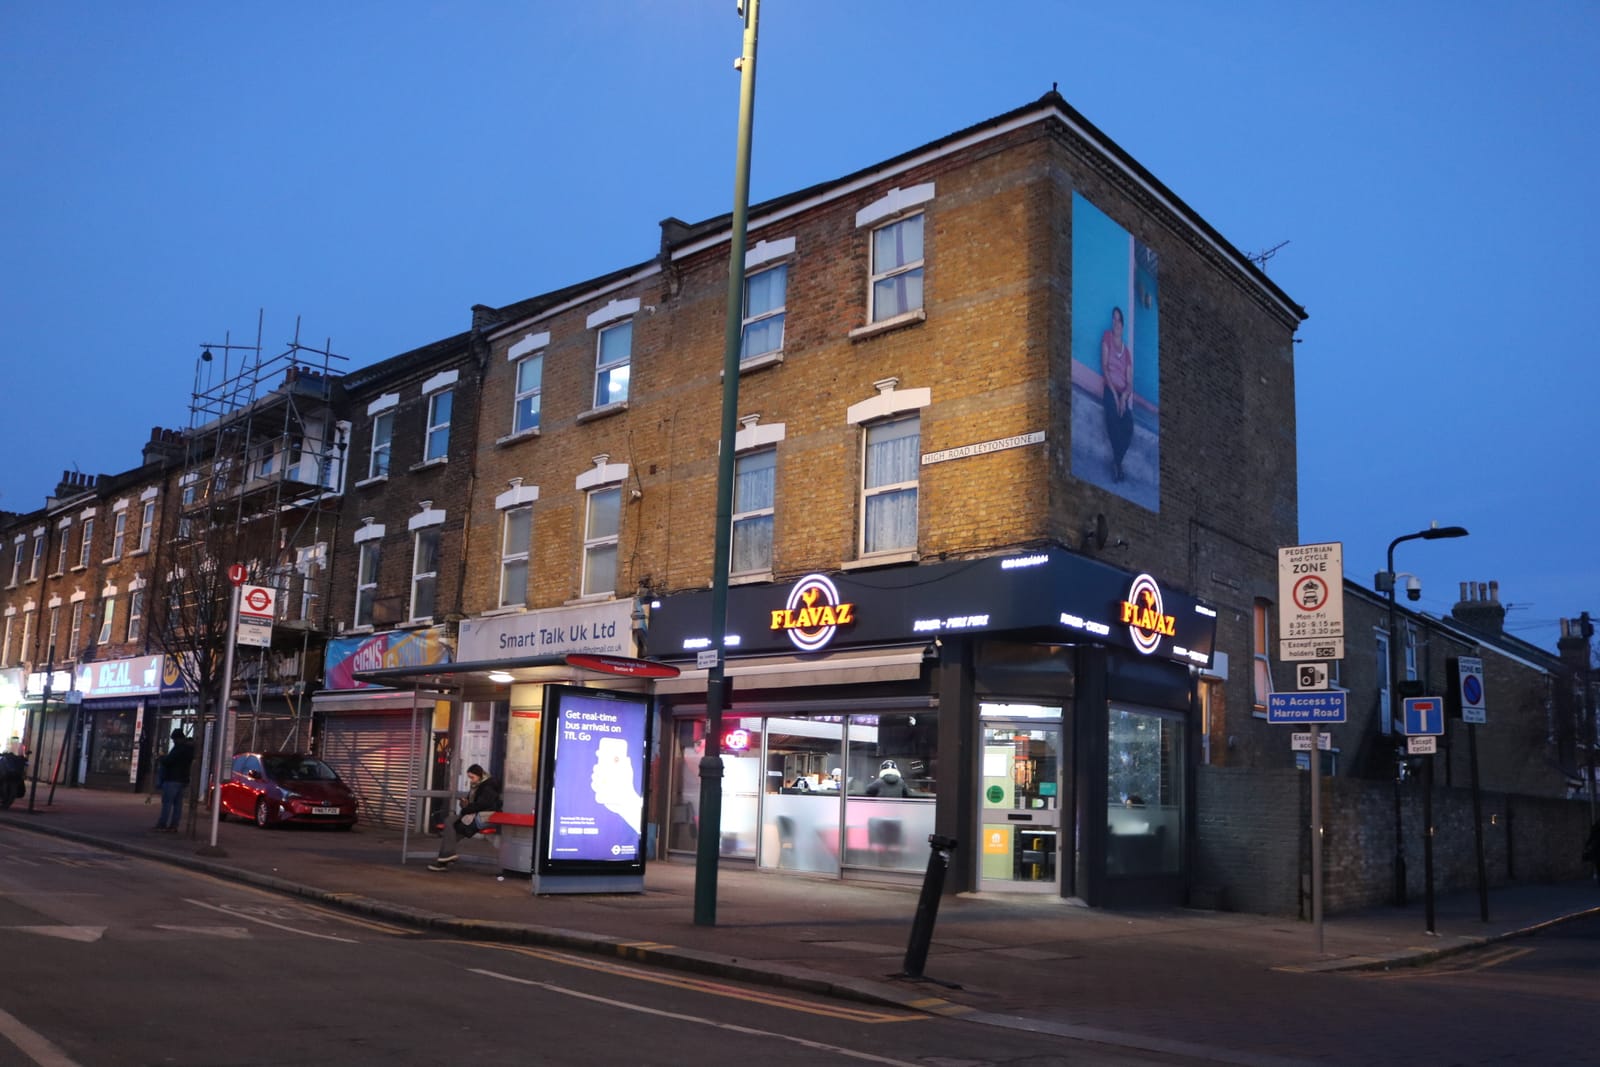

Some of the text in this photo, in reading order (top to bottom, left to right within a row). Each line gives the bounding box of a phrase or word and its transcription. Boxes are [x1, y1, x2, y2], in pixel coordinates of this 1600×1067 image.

[925, 452, 945, 463] HIGH
[948, 447, 970, 460] ROAD
[973, 435, 1033, 454] LEYTONSTONE
[1285, 546, 1333, 556] PEDESTRIAN
[1304, 553, 1329, 561] CYCLE
[233, 567, 242, 580] J
[1293, 562, 1327, 574] ZONE
[769, 603, 854, 630] FLAVAZ
[1120, 600, 1175, 637] FLAVAZ
[499, 621, 616, 649] Smart Talk Uk Ltd
[1288, 640, 1312, 648] Except
[353, 639, 382, 672] SIGNS
[1272, 697, 1341, 706] No Access to
[565, 710, 617, 723] Get real-time
[1274, 708, 1340, 718] Harrow Road
[565, 721, 621, 733] bus arrivals on
[564, 731, 592, 741] TfL Go
[726, 733, 747, 747] OPEN
[1293, 734, 1312, 742] Excep
[1411, 737, 1433, 745] Except
